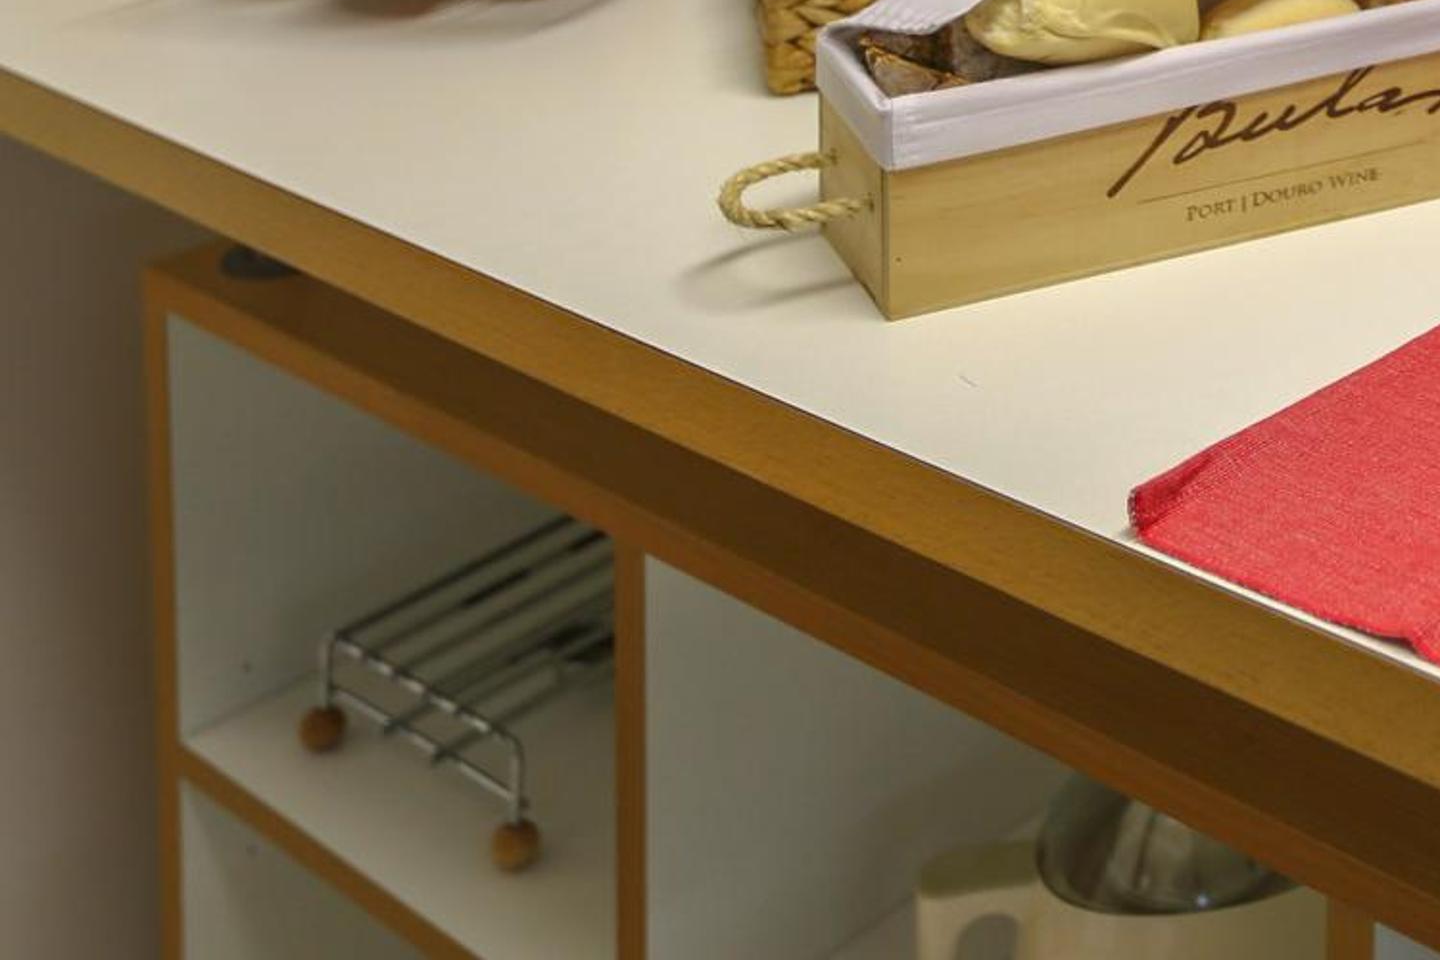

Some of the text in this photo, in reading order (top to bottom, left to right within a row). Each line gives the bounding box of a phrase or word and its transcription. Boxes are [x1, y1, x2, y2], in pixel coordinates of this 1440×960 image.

[1186, 199, 1238, 222] PORT
[1252, 180, 1323, 208] DOURO
[1327, 167, 1381, 190] WINE
